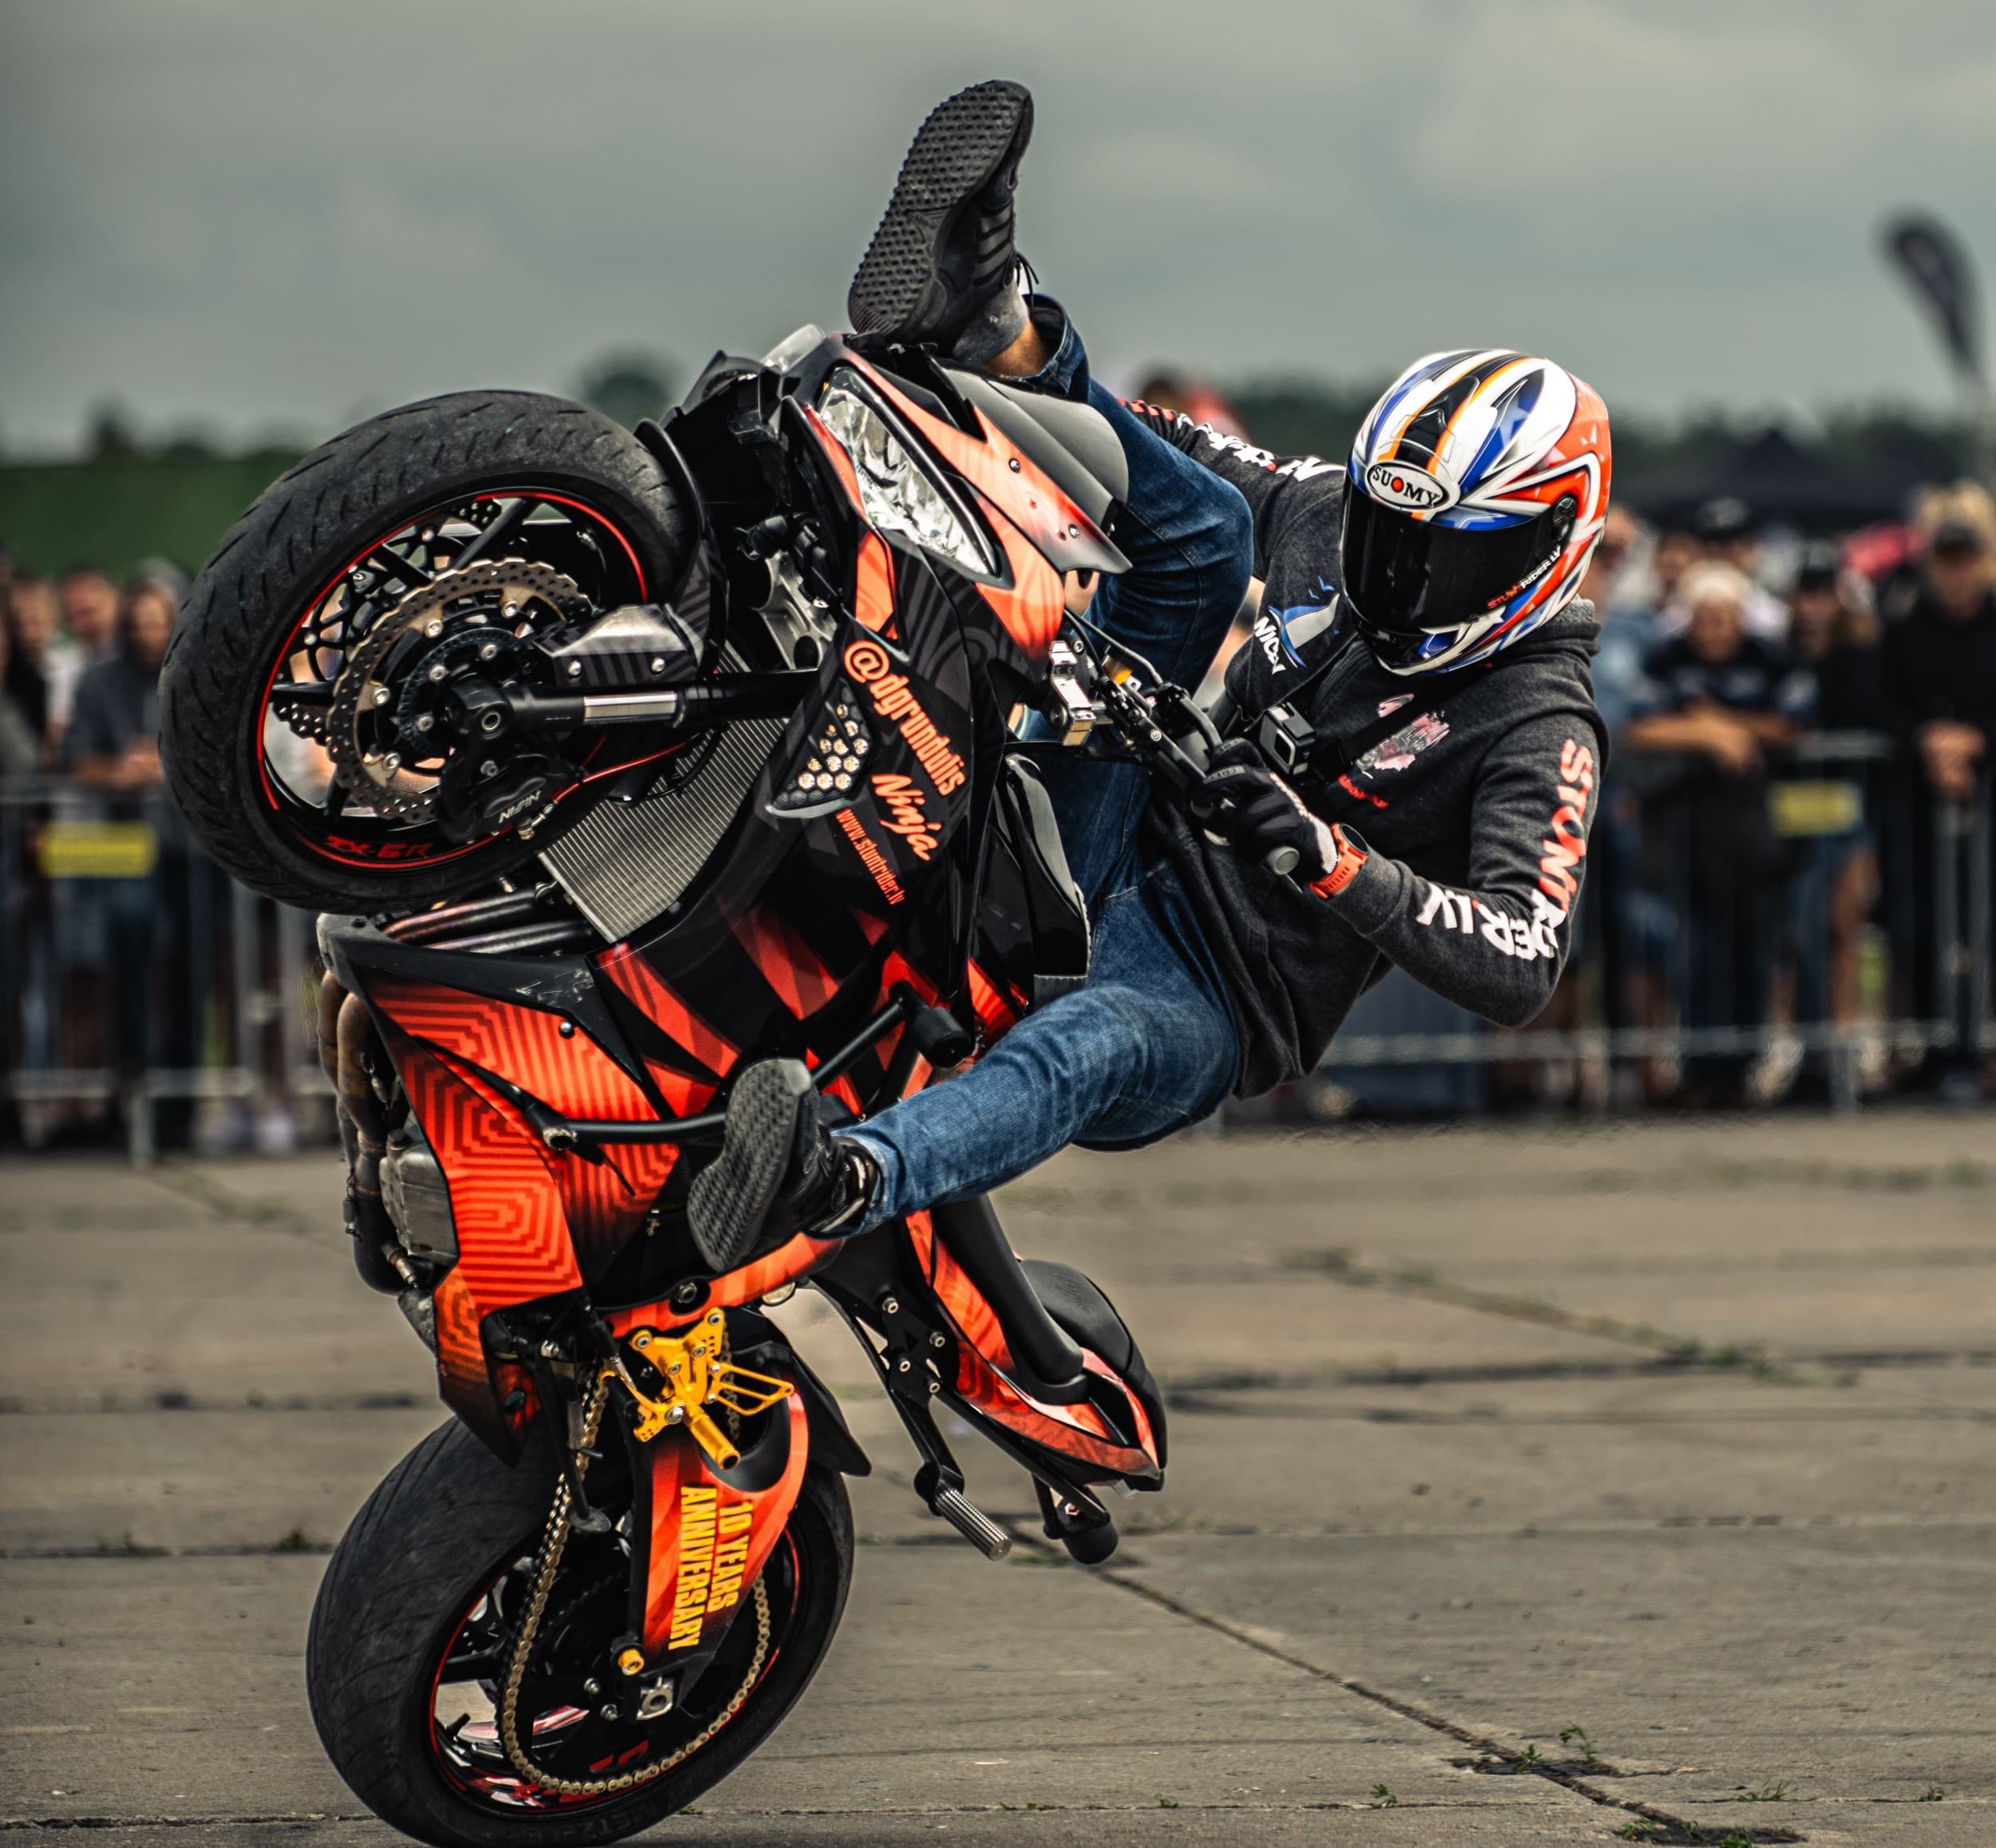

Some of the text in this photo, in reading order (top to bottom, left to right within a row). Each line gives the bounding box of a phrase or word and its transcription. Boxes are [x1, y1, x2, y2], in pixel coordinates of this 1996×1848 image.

[1372, 465, 1440, 507] SUOMY
[844, 639, 966, 797] @dgrundulis
[836, 809, 905, 905] www.stuntrider.lv
[871, 774, 942, 861] Ninja
[667, 1486, 717, 1651] ANNIVERSARY
[707, 1501, 754, 1613] 10 YEARS
